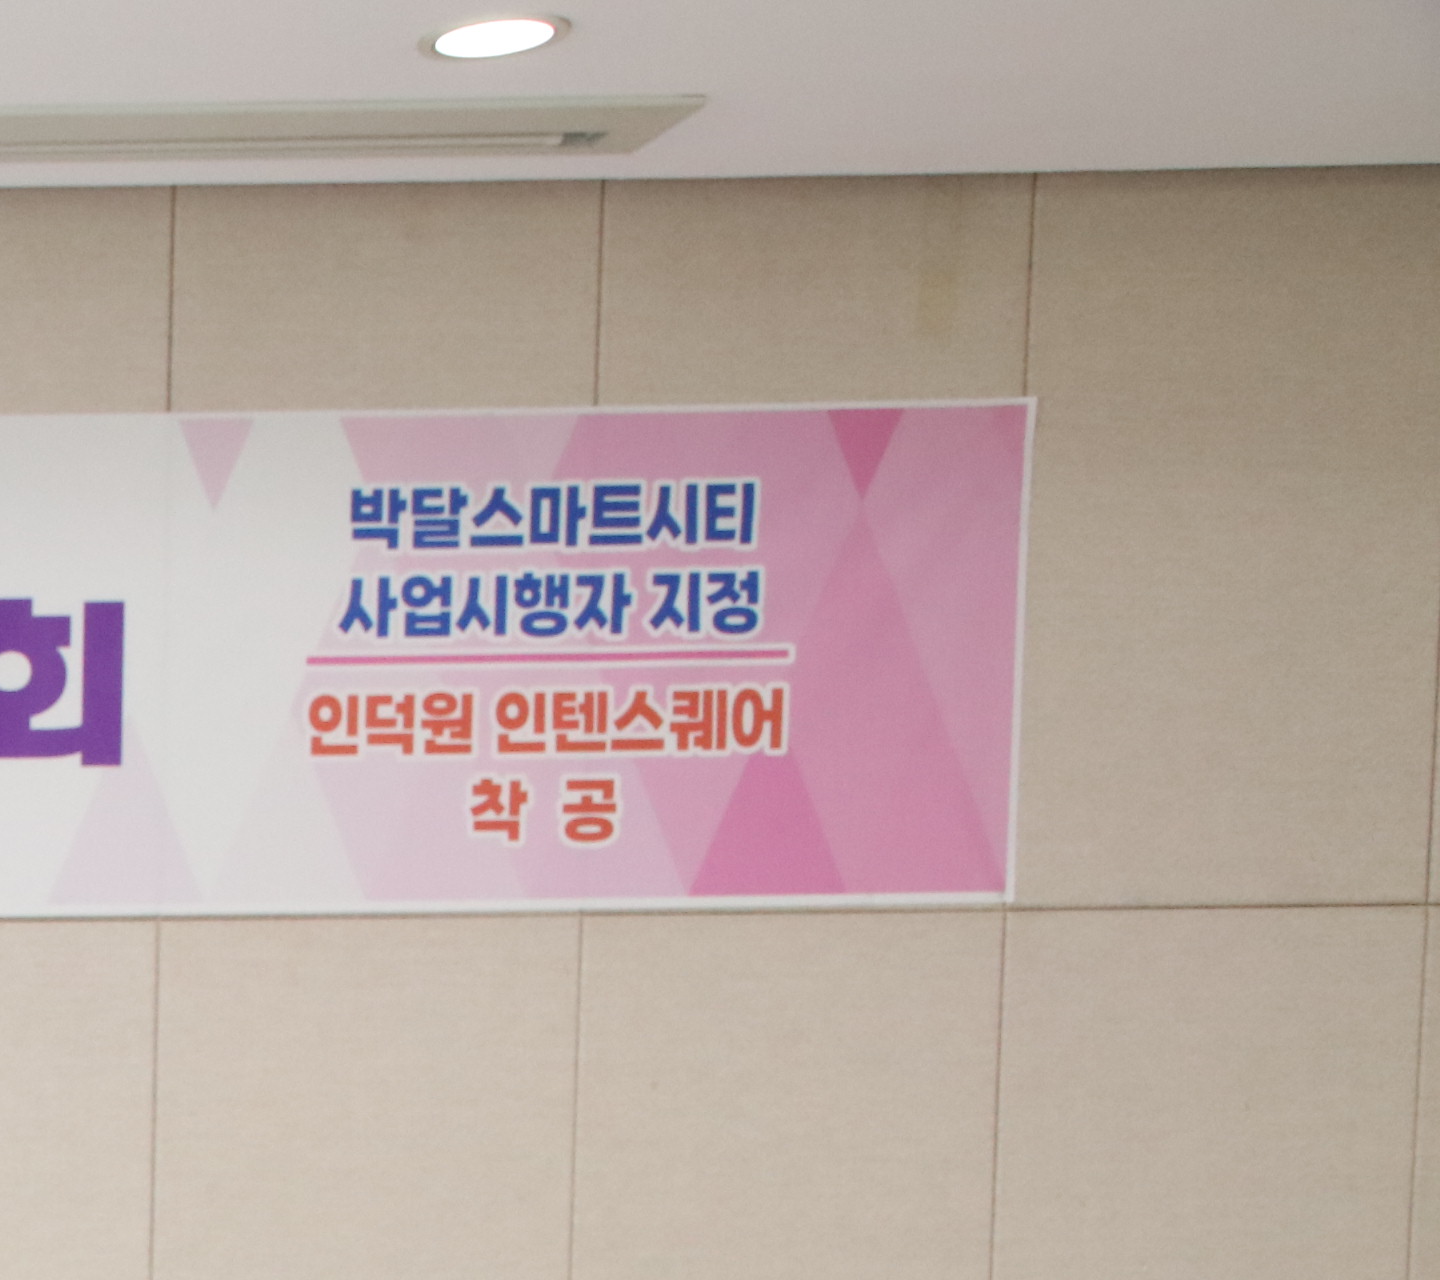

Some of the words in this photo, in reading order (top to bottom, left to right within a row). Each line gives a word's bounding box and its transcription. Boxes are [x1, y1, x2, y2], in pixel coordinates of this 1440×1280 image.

[351, 483, 756, 549] 박달스마트시티
[339, 571, 632, 637] 사업시행자
[649, 570, 761, 633] 지정
[308, 693, 474, 756] 인덕원
[495, 688, 785, 753] 인텐스퀘어
